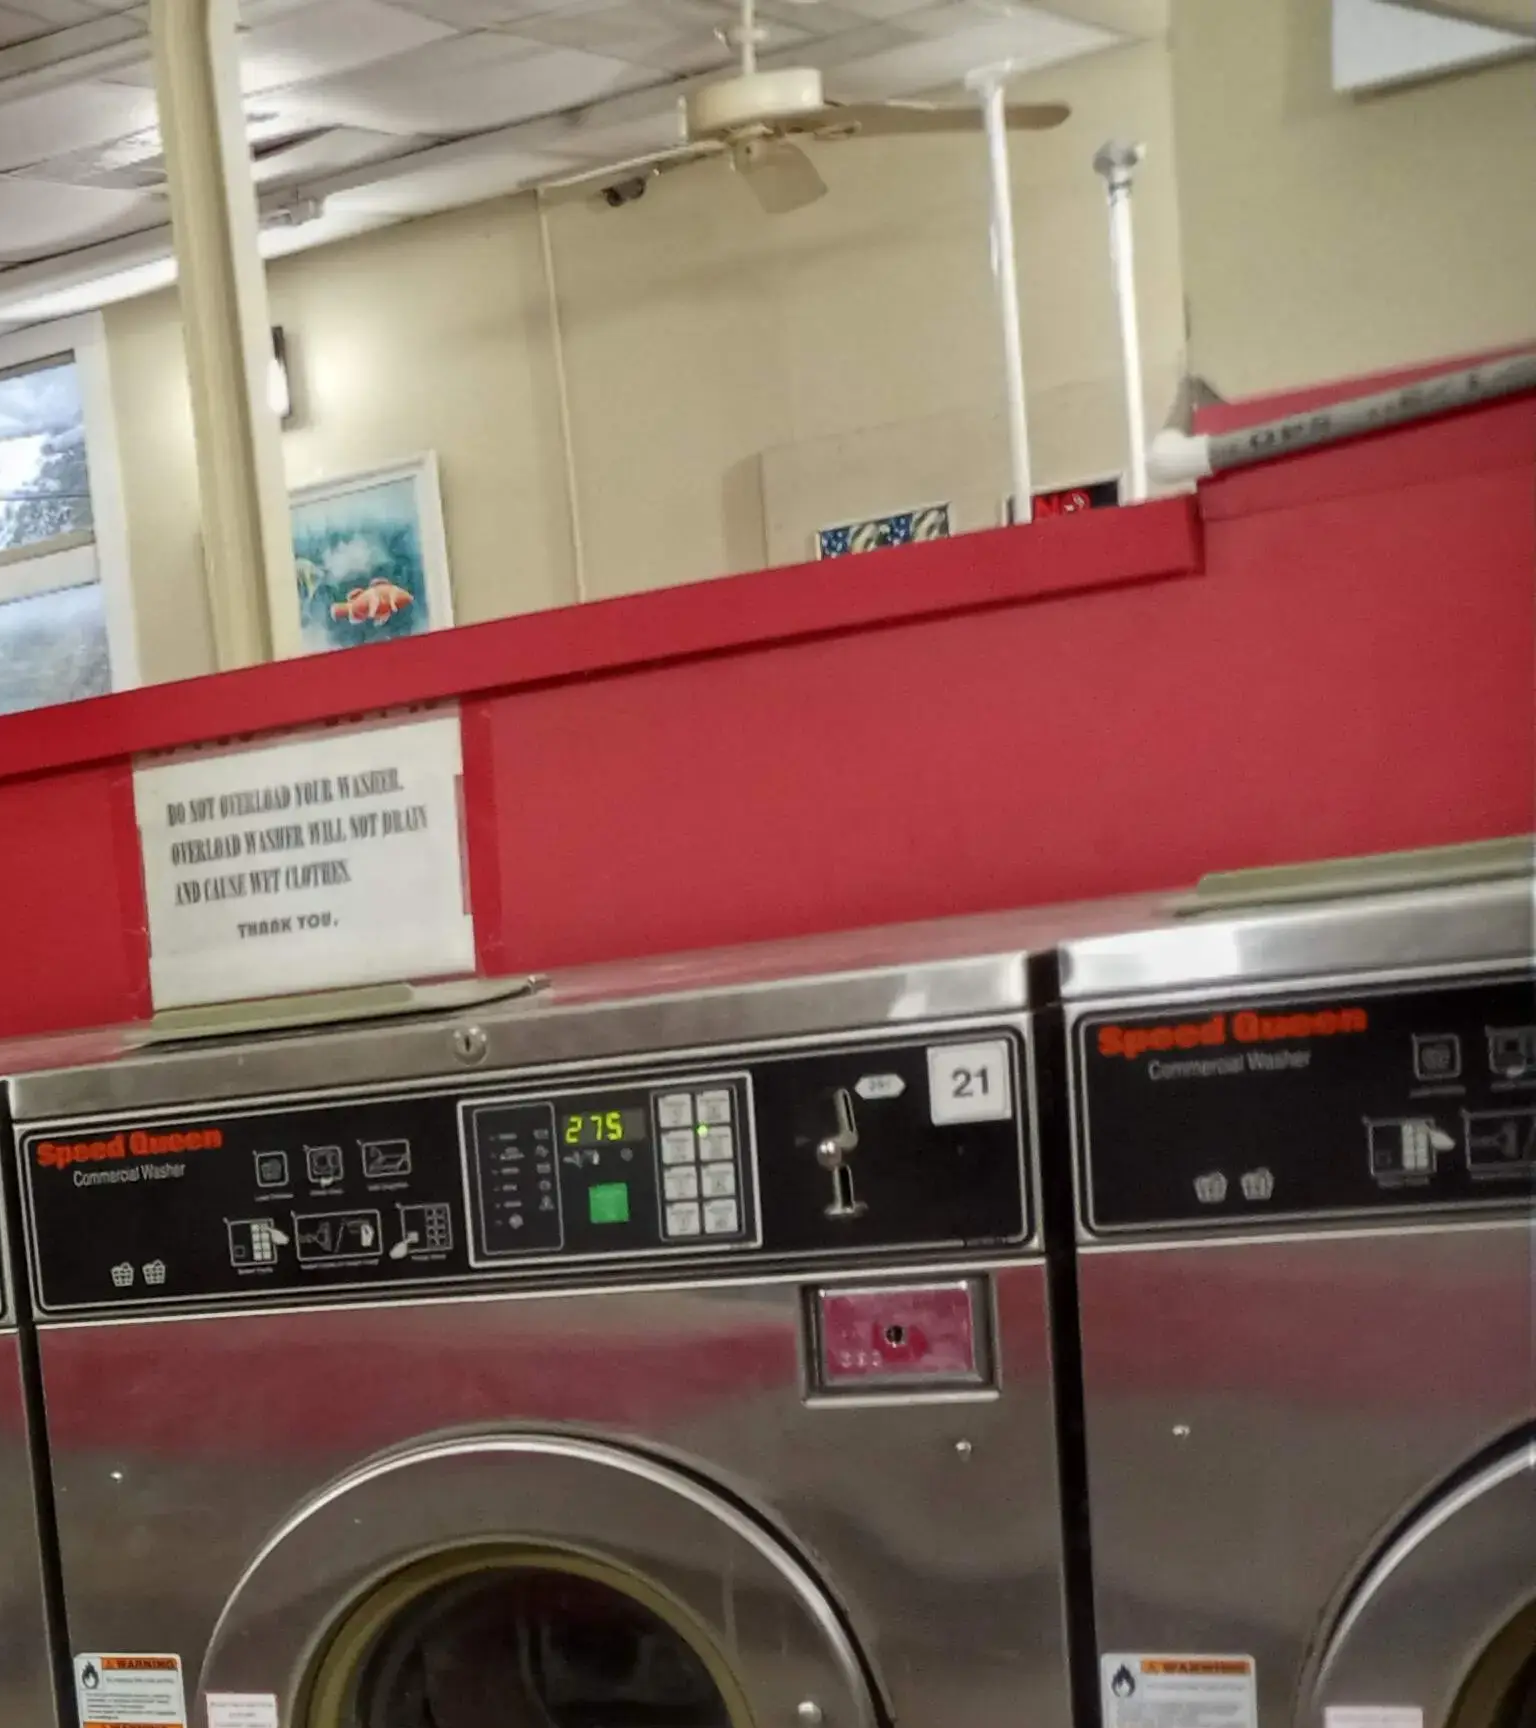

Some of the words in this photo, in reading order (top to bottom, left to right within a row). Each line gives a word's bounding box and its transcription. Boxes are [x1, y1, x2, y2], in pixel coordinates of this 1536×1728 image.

[167, 801, 185, 827] DO
[190, 796, 215, 822] NOT
[220, 784, 291, 820] OVERLOAD
[294, 778, 333, 809] YOUR
[171, 832, 241, 866] OVERLOAD
[245, 825, 305, 855] WASHER
[308, 818, 347, 847] WILL
[350, 813, 377, 839] NOT
[382, 805, 428, 838] DRAIN
[175, 881, 202, 906] AND
[204, 873, 247, 904] CAUSE
[250, 868, 281, 897] WET
[238, 917, 292, 939] THANK
[1098, 1013, 1225, 1058] Speed
[1233, 1008, 1368, 1042] Queen
[1148, 1055, 1244, 1080] Commercial
[1248, 1049, 1311, 1071] Washer
[951, 1067, 991, 1098] 21
[565, 1111, 623, 1143] 275
[37, 1134, 125, 1169] Speed
[127, 1127, 224, 1157] Queen
[73, 1167, 139, 1187] Commercial
[141, 1161, 186, 1180] Washer
